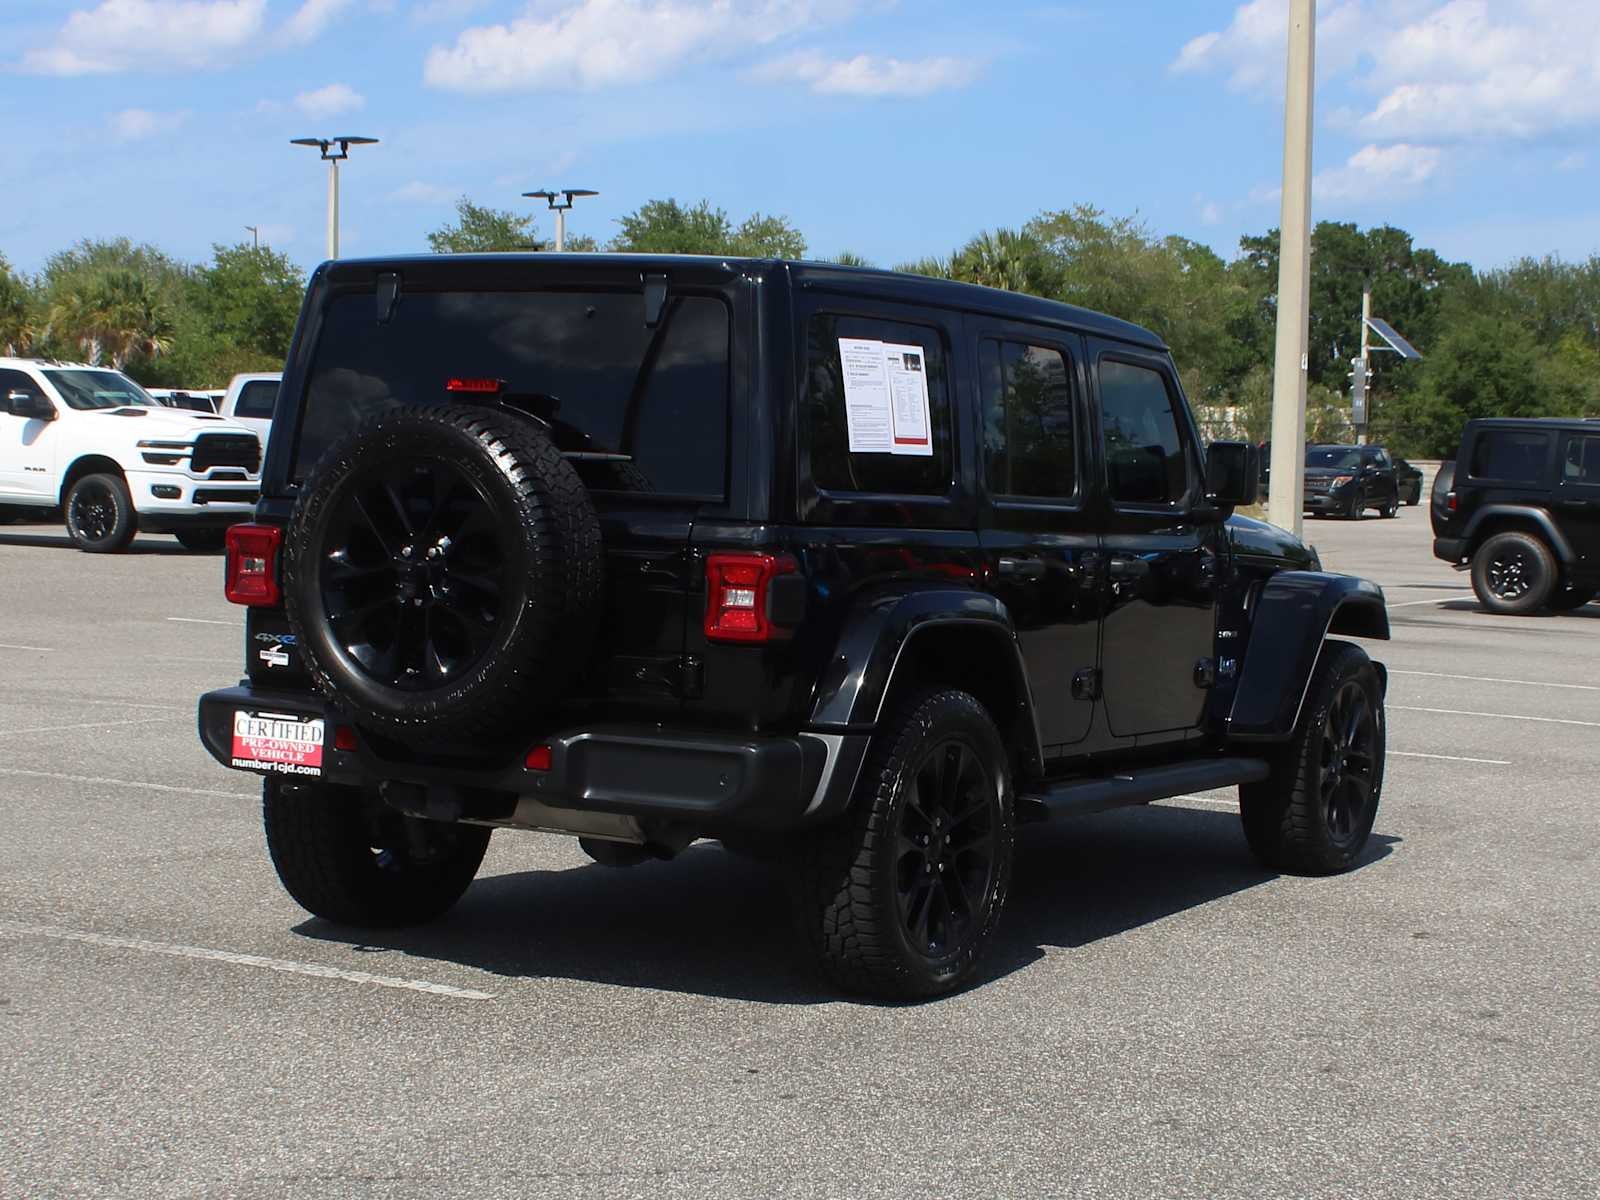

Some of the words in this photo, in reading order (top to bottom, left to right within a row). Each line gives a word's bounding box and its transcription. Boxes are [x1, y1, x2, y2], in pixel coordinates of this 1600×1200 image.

[236, 719, 321, 742] CERTIFIED
[242, 738, 315, 753] PRE-OWNED
[250, 749, 304, 762] VEHICLE
[232, 758, 320, 776] number1cjd.com
